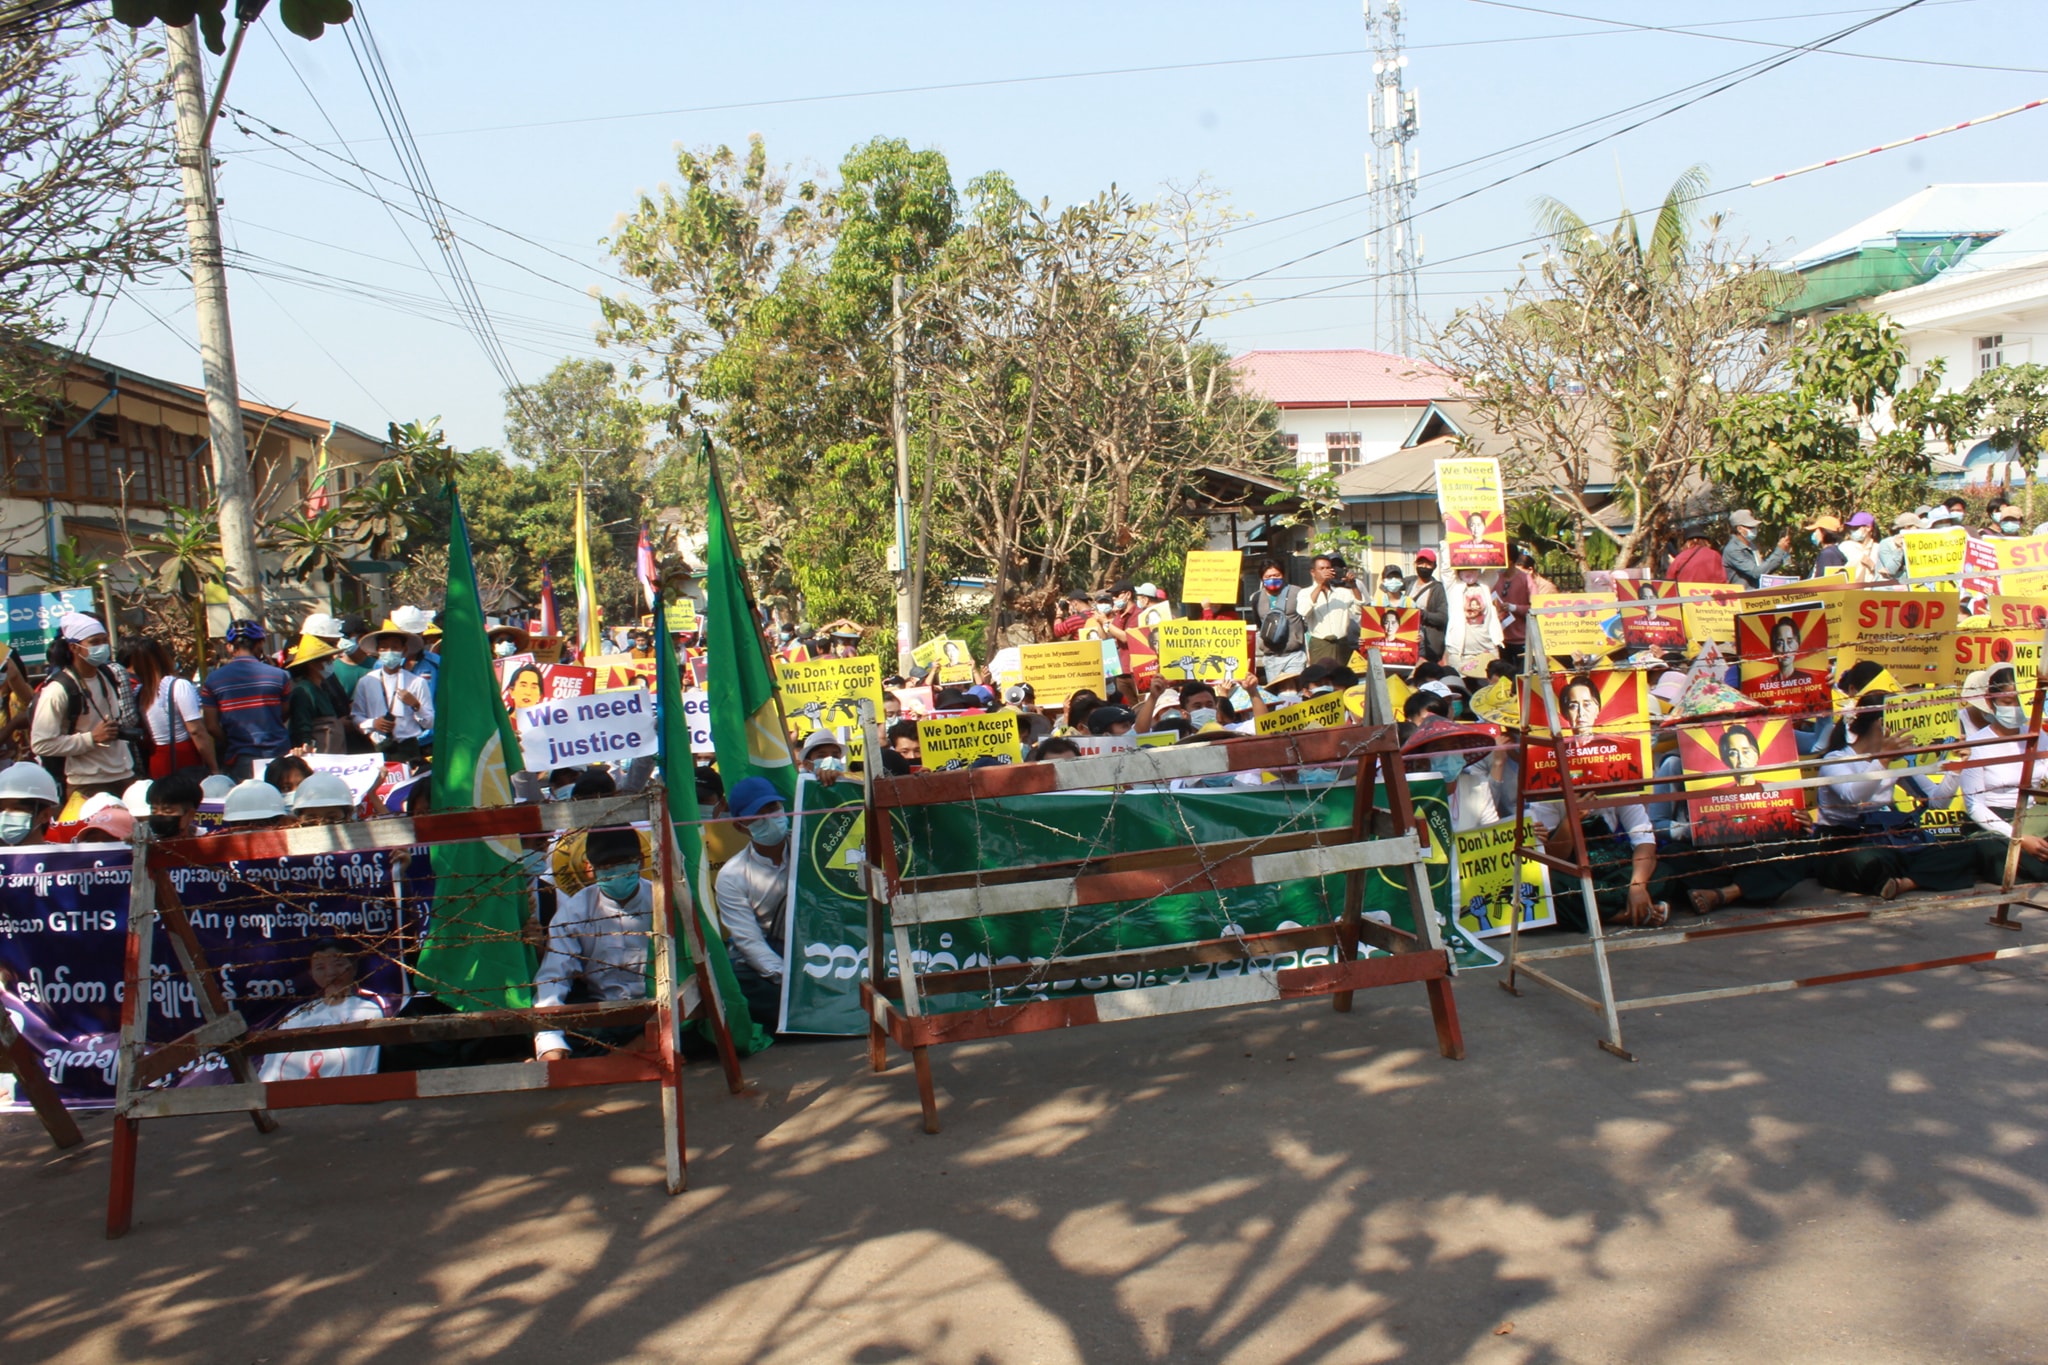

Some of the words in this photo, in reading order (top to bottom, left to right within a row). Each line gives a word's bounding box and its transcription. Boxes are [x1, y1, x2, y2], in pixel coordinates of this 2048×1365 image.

[1463, 466, 1495, 475] Need
[1946, 551, 1965, 562] COU
[2010, 542, 2048, 566] ST
[1689, 589, 1740, 607] STOP
[1745, 601, 1769, 610] People
[1543, 599, 1605, 618] STOP
[1858, 600, 1945, 629] STOP
[1580, 619, 1601, 627] Peop
[2002, 604, 2048, 629] STO
[1164, 626, 1179, 636] We
[1182, 626, 1209, 636] Don't
[1211, 626, 1243, 637] Accept
[1577, 627, 1601, 635] Midnigh
[530, 638, 557, 650] TOP
[1166, 638, 1212, 649] MILITARY
[1215, 638, 1242, 649] COUP
[1855, 645, 1888, 655] Illegally
[1955, 636, 2029, 664] STO
[1023, 652, 1043, 660] People
[1052, 649, 1080, 658] Myanmar
[2016, 646, 2032, 658] We
[782, 669, 800, 681] We
[804, 666, 835, 679] Don't
[838, 662, 876, 677] Accept
[1025, 663, 1046, 671] Agreed
[1062, 660, 1092, 668] Decisions
[552, 675, 583, 690] FREE
[1025, 674, 1045, 682] United
[1048, 672, 1065, 680] States
[1077, 670, 1101, 678] America
[786, 680, 840, 695] MILITARY
[843, 677, 875, 690] COUP
[1750, 690, 1774, 699] LEADER
[1777, 688, 1801, 697] FUTURE
[1804, 684, 1822, 692] HOPE
[1760, 681, 1780, 690] PLEASE
[1781, 680, 1797, 688] SAVE
[553, 687, 581, 699] OUR
[527, 704, 568, 728] We
[577, 694, 642, 721] need
[1885, 699, 1899, 714] We
[1260, 718, 1277, 732] We
[1279, 708, 1307, 726] Don't
[1308, 698, 1341, 716] Accept
[1316, 712, 1340, 728] OUP
[1886, 712, 1931, 733] MILITARY
[1935, 710, 1957, 725] COUP
[923, 725, 941, 738] We
[945, 722, 974, 736] Don't
[978, 717, 1014, 733] Accept
[549, 731, 641, 765] justice
[928, 735, 979, 753] MILITARY
[982, 732, 1013, 747] COUP
[1577, 746, 1600, 756] SAVE
[1600, 745, 1618, 754] OUR
[1534, 760, 1558, 769] LEAD
[1571, 755, 1605, 765] FUTURE
[1608, 753, 1632, 762] HOPE
[1711, 794, 1738, 803] PLEASE
[1739, 792, 1761, 801] SAVE
[1762, 791, 1780, 799] OUR
[1699, 804, 1731, 813] LEADER
[1735, 801, 1768, 811] FUTURE
[1770, 799, 1795, 808] HOPE
[1920, 811, 1966, 826] EADER
[1458, 831, 1490, 854] Don't
[1493, 822, 1533, 845] Accpt
[49, 909, 117, 933] GTHS
